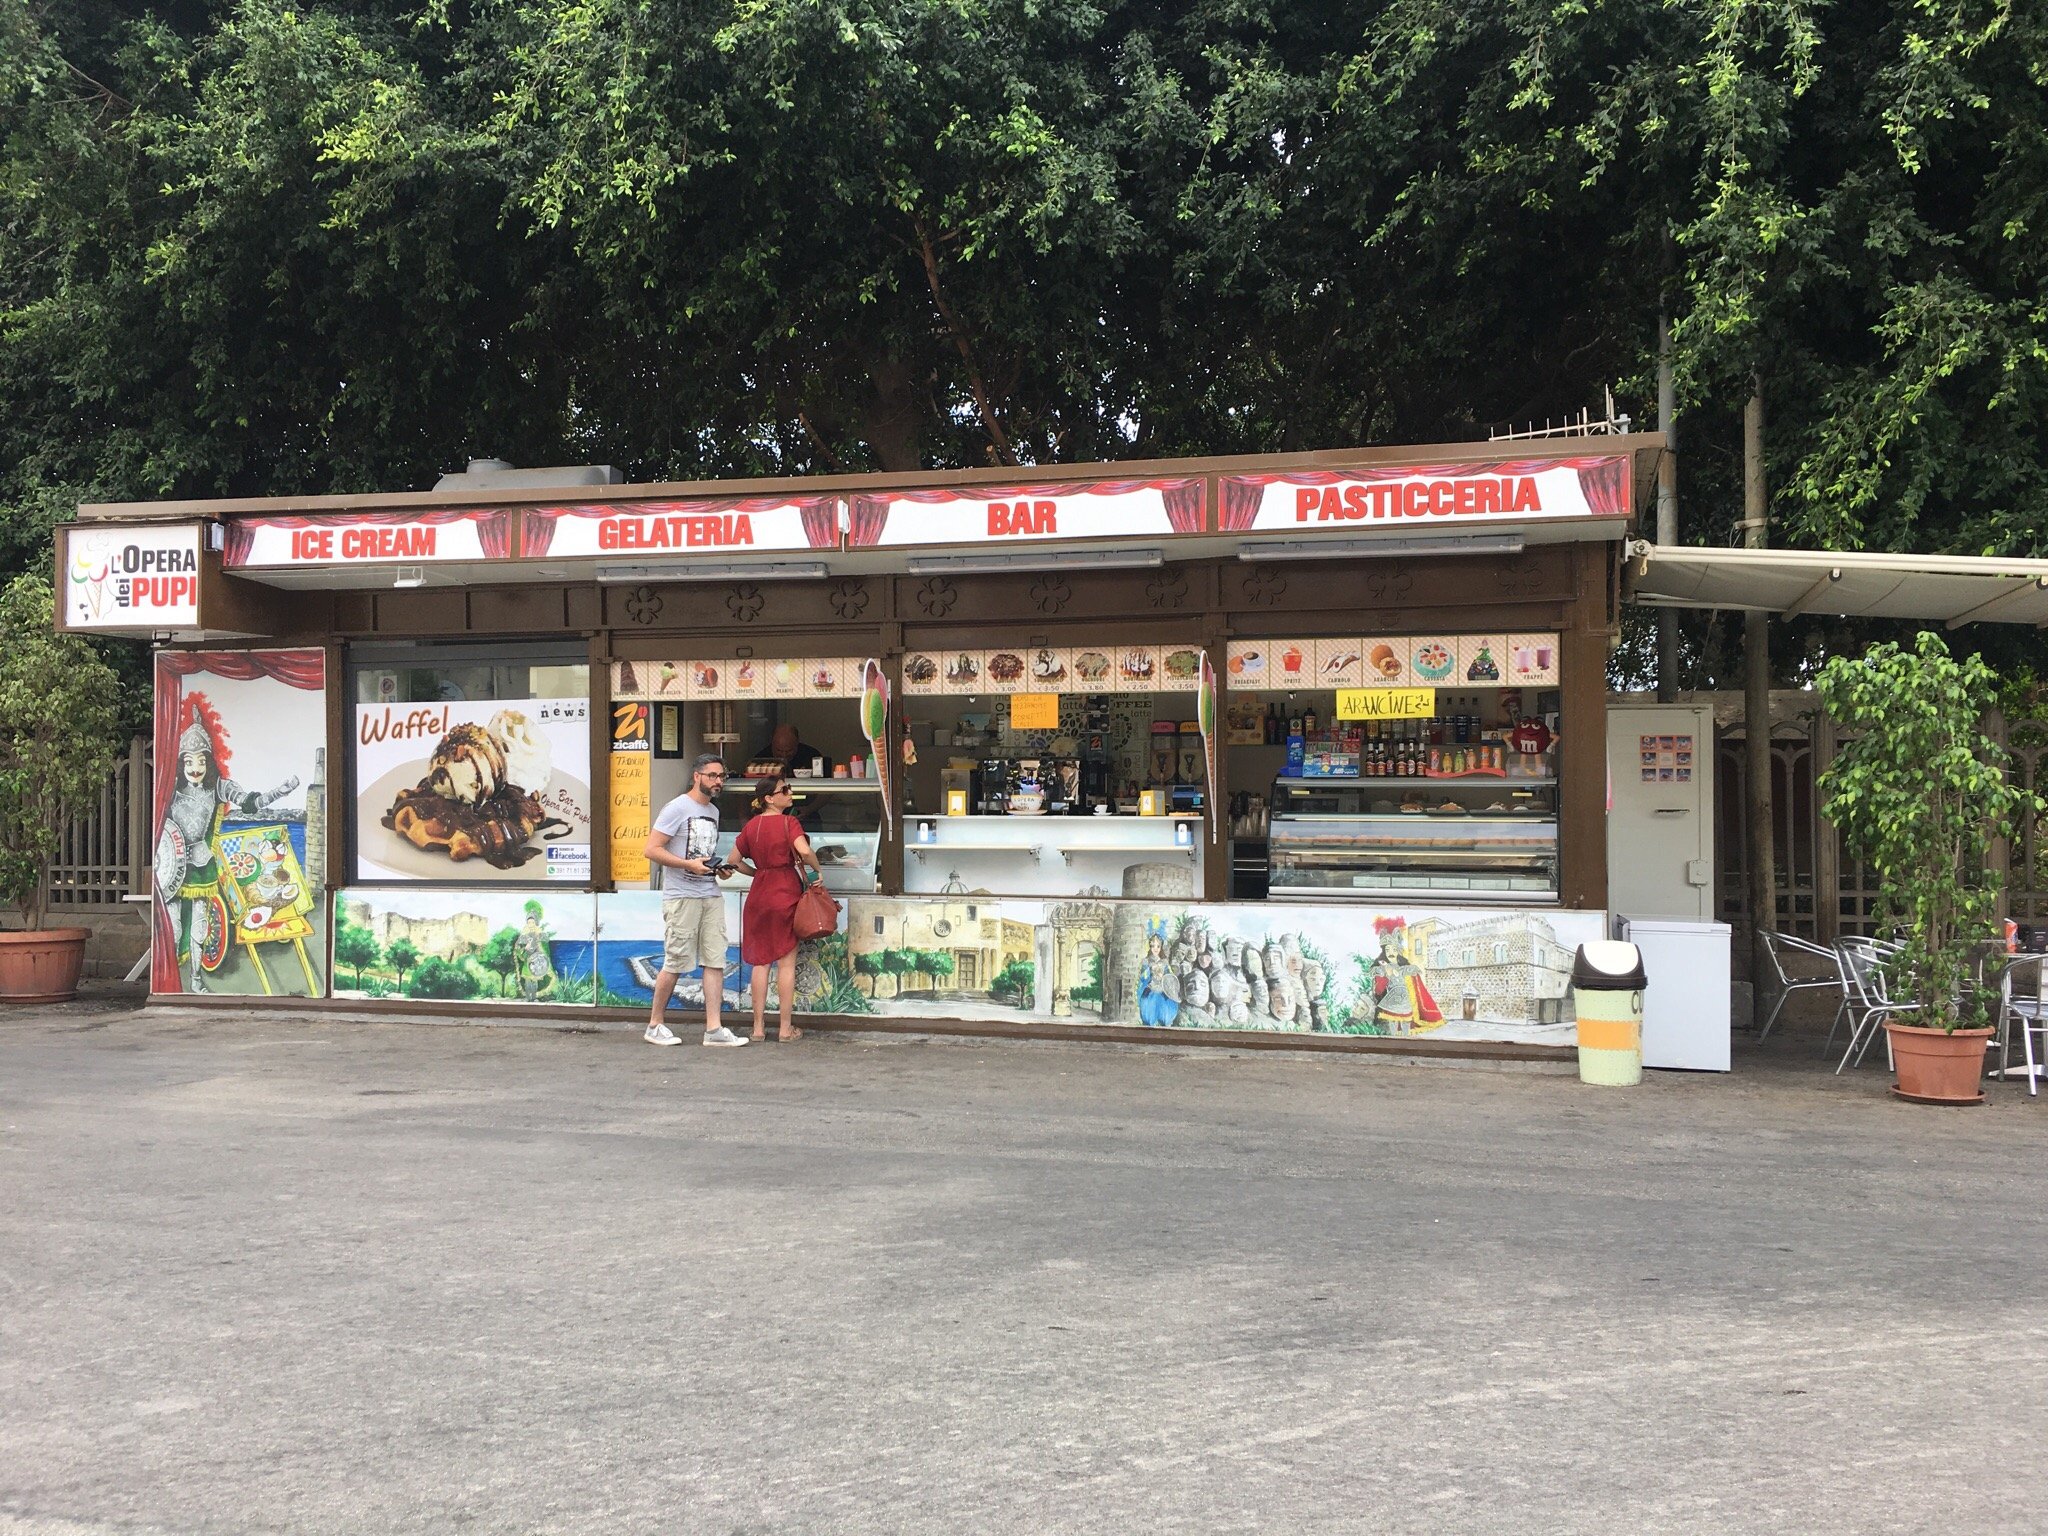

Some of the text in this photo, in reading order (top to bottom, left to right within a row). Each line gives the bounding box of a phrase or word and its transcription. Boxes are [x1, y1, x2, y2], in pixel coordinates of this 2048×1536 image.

[1296, 477, 1542, 522] PASTICCERIA
[599, 514, 754, 549] GELATERIA
[988, 501, 1057, 536] BAR
[291, 527, 436, 559] ICE CREAM
[116, 576, 197, 607] dei PUPI
[540, 707, 585, 719] news
[1343, 690, 1415, 716] ARANCINE
[361, 705, 449, 745] Waffel
[613, 739, 649, 750] zicaffè
[540, 793, 560, 811] Opera
[562, 806, 571, 815] dei
[558, 788, 574, 806] Bar
[170, 827, 184, 856] PUPI
[168, 865, 184, 893] OPERA
